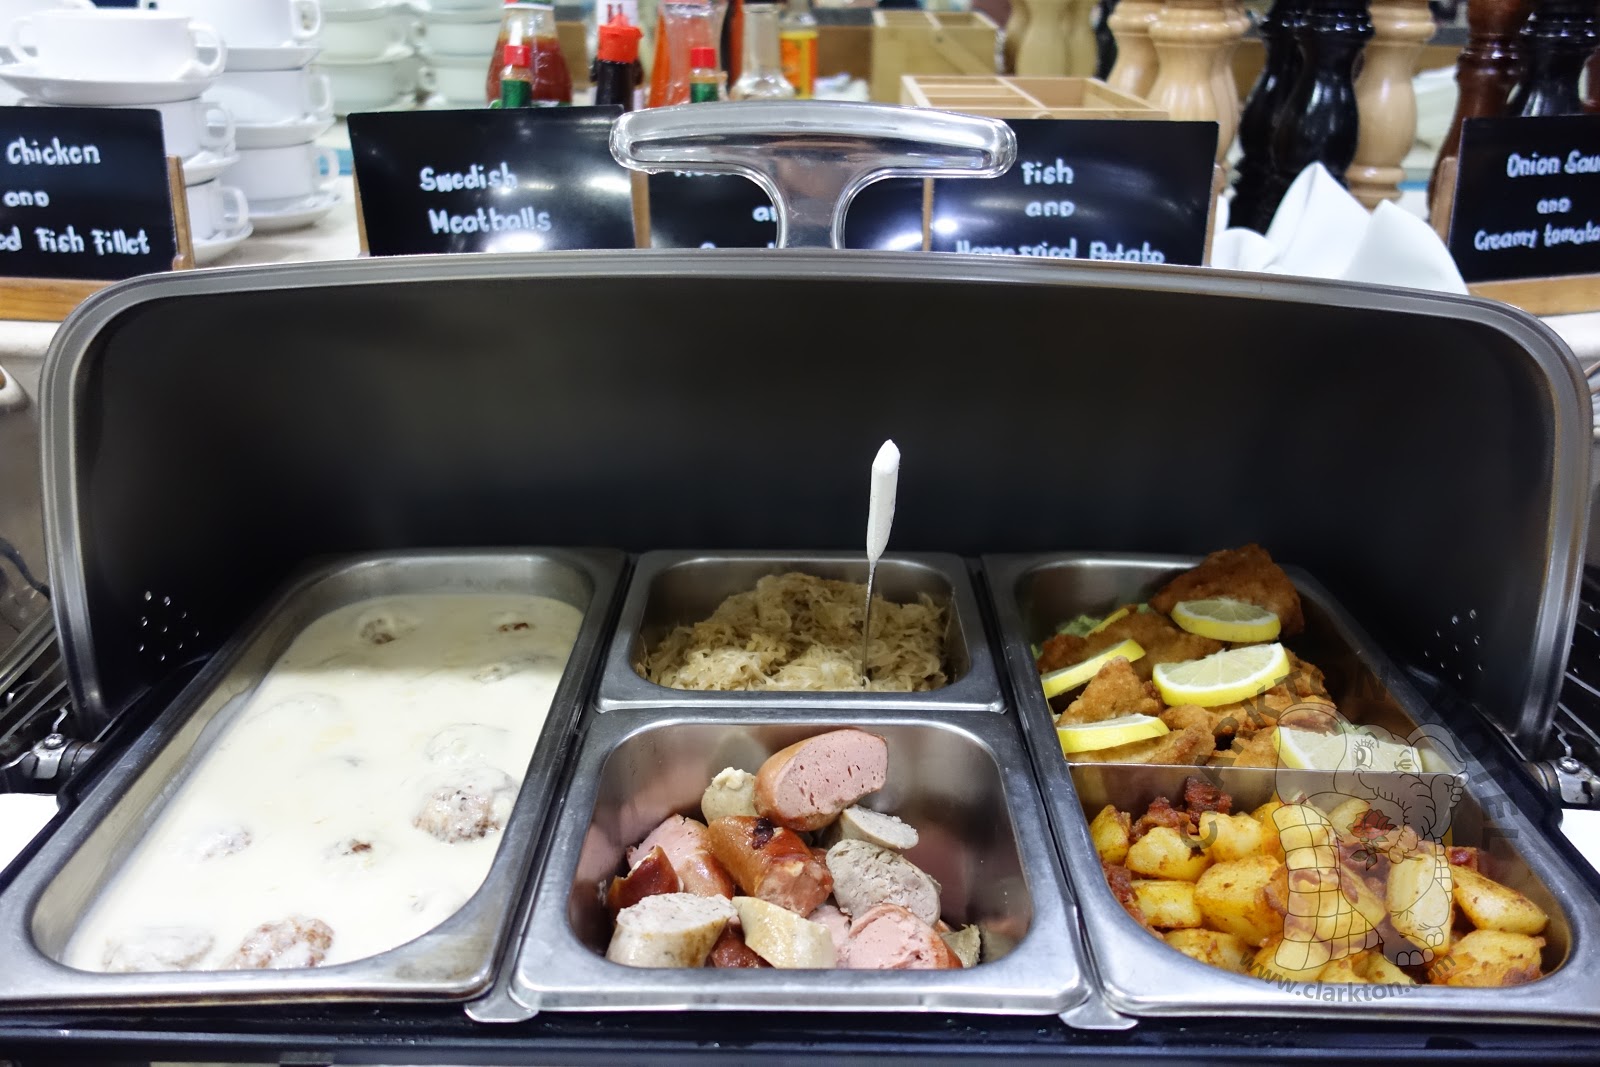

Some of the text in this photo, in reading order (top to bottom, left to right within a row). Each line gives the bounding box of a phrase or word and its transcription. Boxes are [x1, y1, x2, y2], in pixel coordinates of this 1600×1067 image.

[7, 136, 101, 165] Chicken
[420, 162, 518, 193] Swedish
[1021, 158, 1074, 185] Fish
[1507, 152, 1561, 178] Onion
[428, 206, 552, 234] Meatballs
[34, 225, 84, 253] Fish
[91, 228, 150, 256] Fillet
[1474, 228, 1538, 251] Creamy
